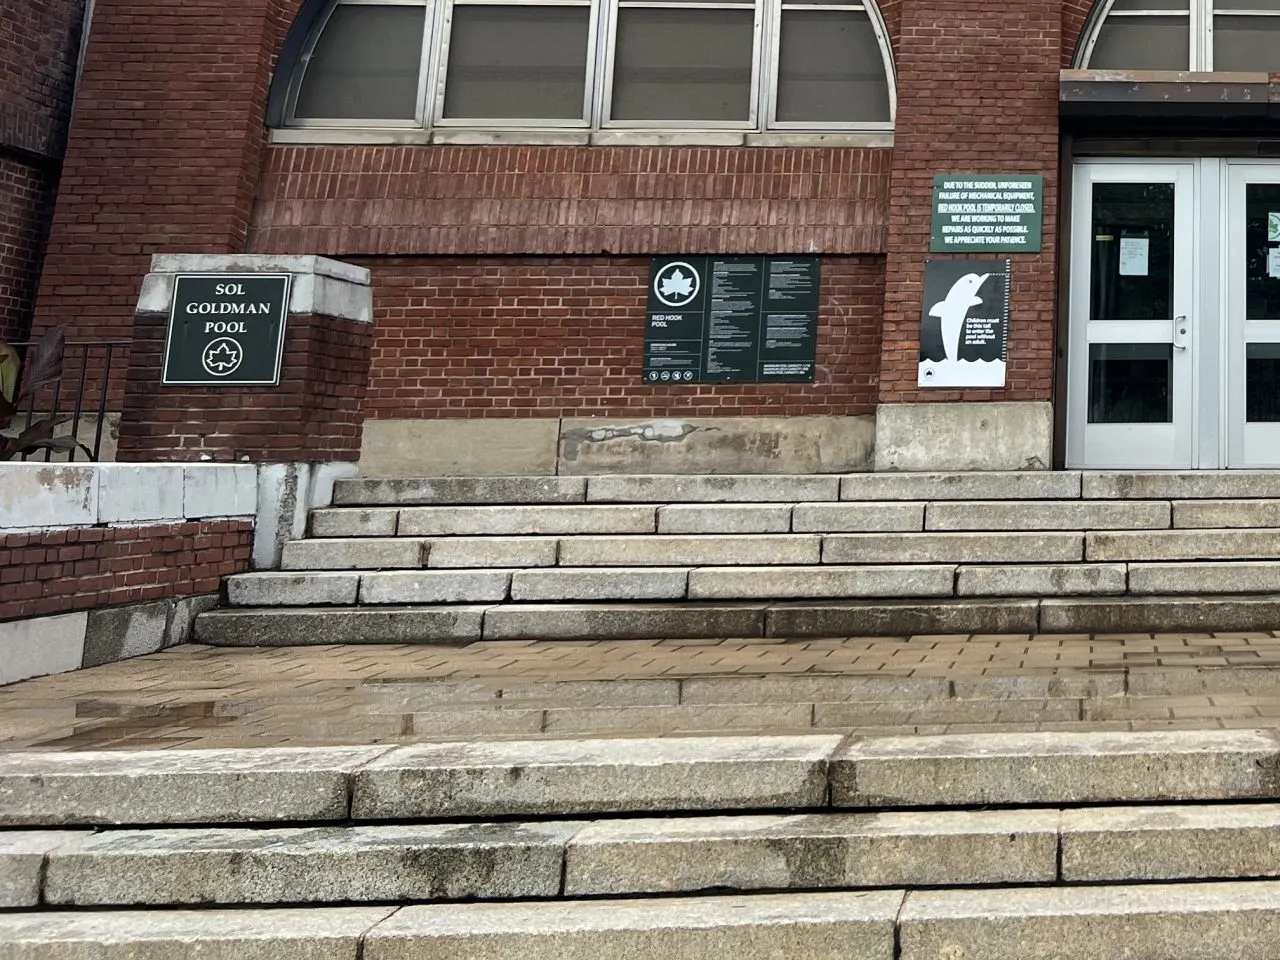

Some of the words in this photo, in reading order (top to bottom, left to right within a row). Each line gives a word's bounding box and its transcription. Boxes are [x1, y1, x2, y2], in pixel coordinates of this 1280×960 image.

[944, 181, 955, 189] DUE
[956, 181, 963, 189] TO
[963, 181, 974, 189] THE
[998, 181, 1032, 189] UNFORESEEN
[939, 192, 960, 200] FAILURE
[961, 192, 968, 200] OF
[969, 192, 1002, 200] MECHANICAL
[938, 203, 948, 212] RED
[949, 203, 963, 212] HOOK
[963, 203, 976, 212] POOL
[977, 203, 982, 212] IS
[982, 203, 1014, 212] TEMPORARILY
[942, 225, 963, 233] REPAIRS
[964, 225, 971, 233] AS
[972, 225, 994, 233] QUICKLY
[995, 225, 1002, 233] AS
[215, 283, 245, 295] SOL
[186, 302, 271, 314] GOLDMAN
[204, 321, 248, 333] POOL
